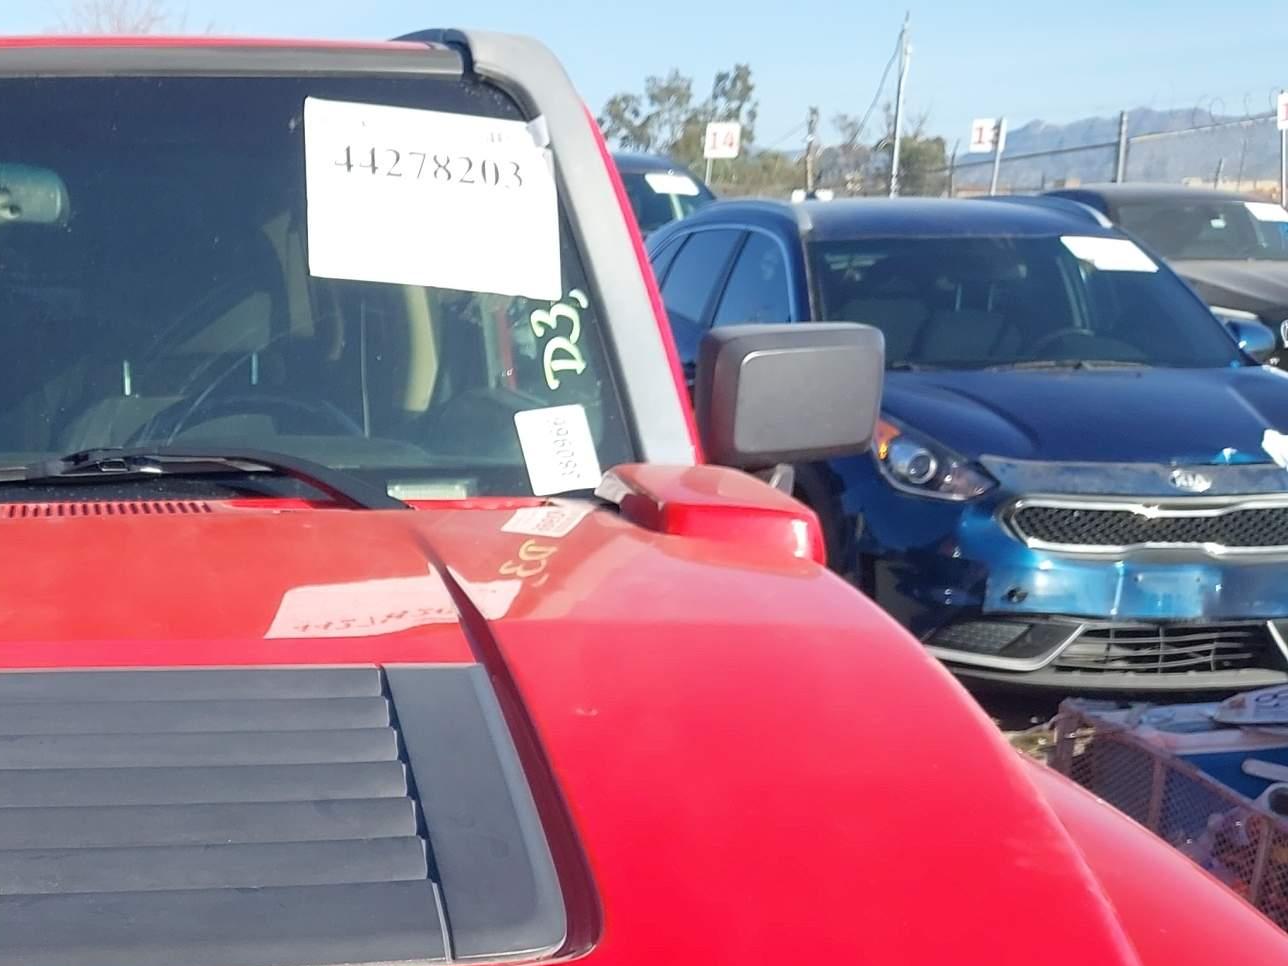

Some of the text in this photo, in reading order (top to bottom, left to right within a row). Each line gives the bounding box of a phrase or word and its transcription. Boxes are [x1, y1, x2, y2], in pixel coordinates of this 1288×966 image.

[711, 131, 734, 149] 14
[334, 145, 523, 188] 44278203
[1174, 472, 1212, 491] KIA
